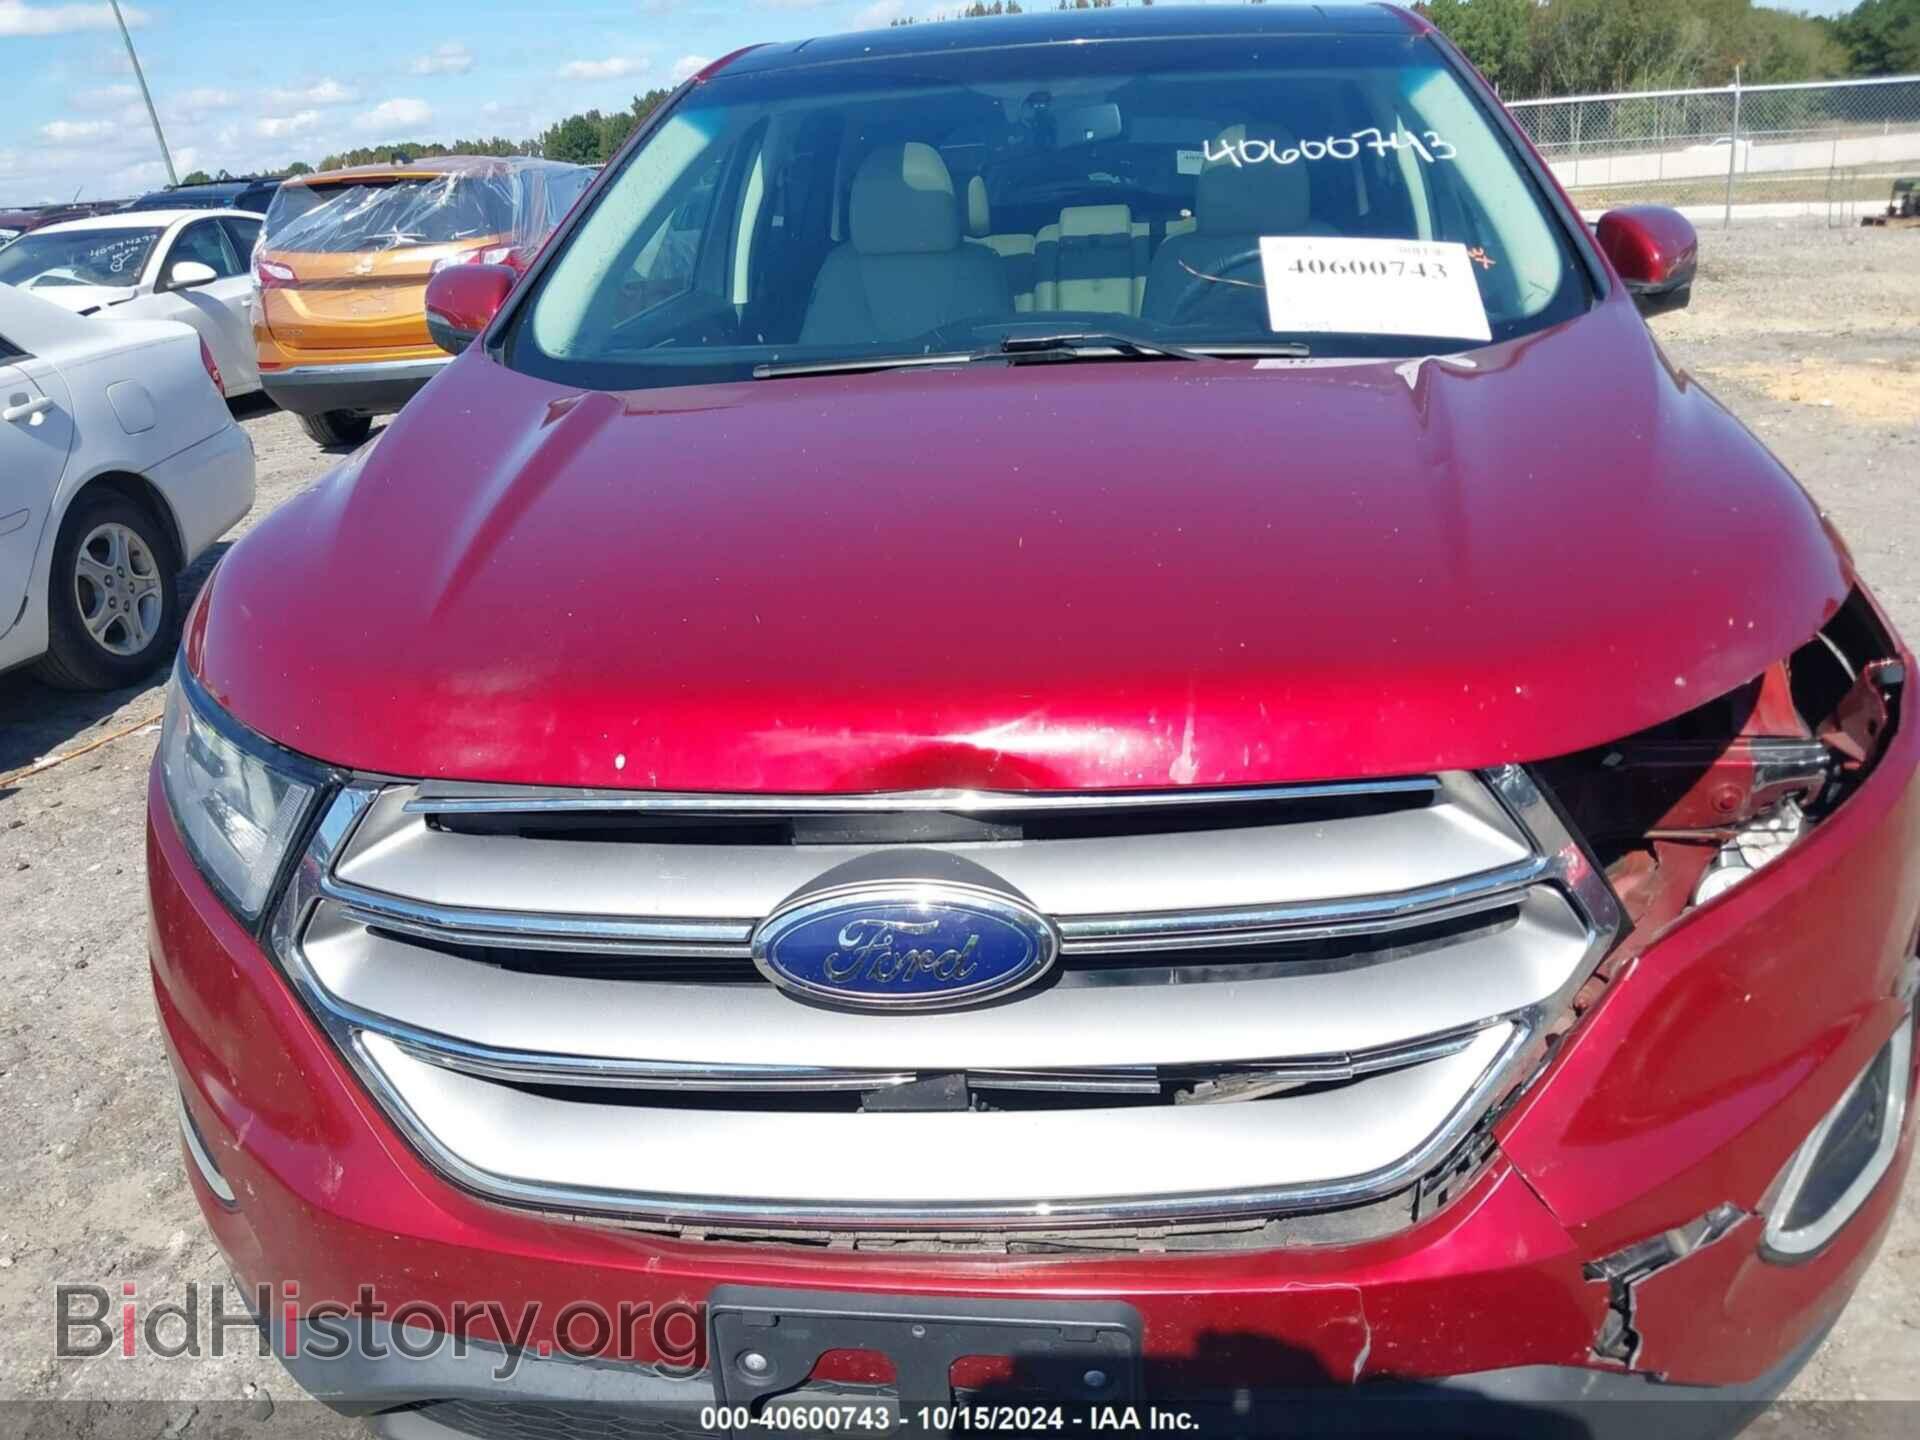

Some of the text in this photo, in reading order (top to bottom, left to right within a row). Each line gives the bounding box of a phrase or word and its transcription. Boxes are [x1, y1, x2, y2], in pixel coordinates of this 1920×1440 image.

[1203, 127, 1457, 167] 40600743
[1287, 258, 1448, 280] 40600743
[823, 919, 980, 984] Ford
